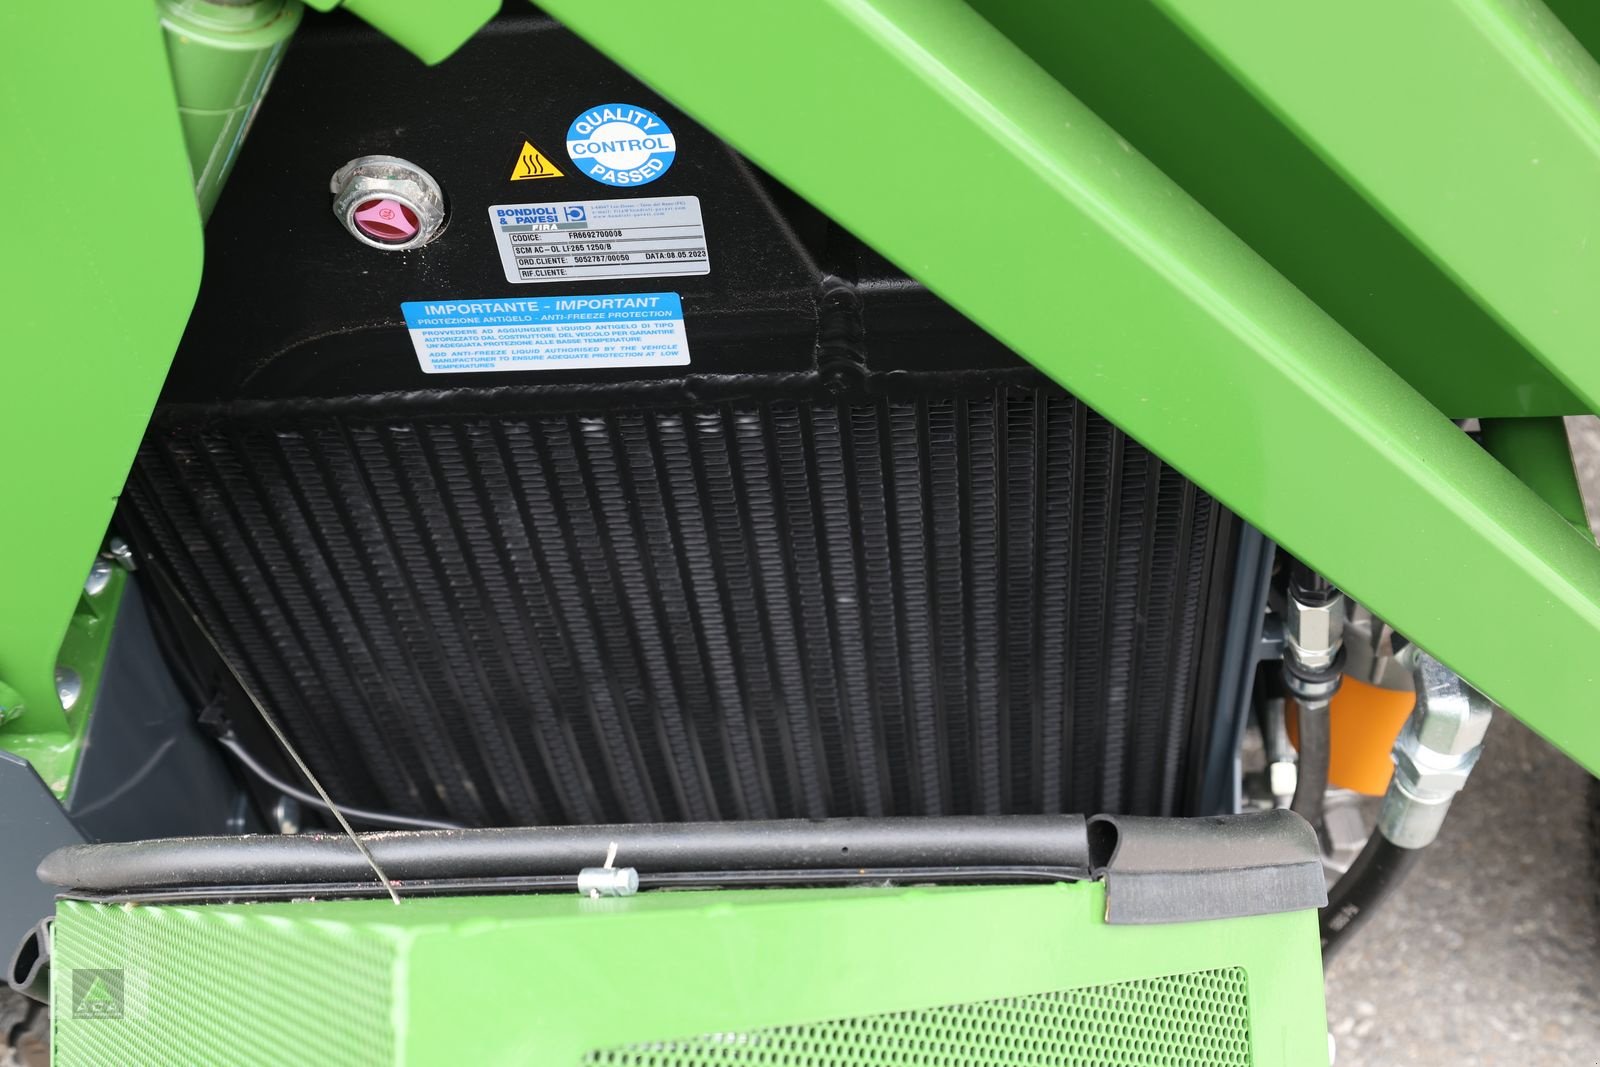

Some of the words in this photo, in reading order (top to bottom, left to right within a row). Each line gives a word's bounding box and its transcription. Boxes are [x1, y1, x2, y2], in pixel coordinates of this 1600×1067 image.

[576, 108, 660, 134] QUALITY
[572, 138, 669, 155] CONTROL
[590, 158, 663, 184] PASSED
[497, 207, 557, 217] BONDIOLI
[516, 215, 559, 224] PAVESI
[519, 257, 568, 266] ORD.CLIENTE:
[574, 254, 630, 263] 5052787/00050
[522, 269, 568, 277] RIF.CLIENTE:
[424, 301, 539, 315] IMPORTANTE
[556, 297, 660, 310] IMPORTANT
[417, 317, 480, 325] PROTEZIONE
[608, 311, 673, 319] PROTECTION
